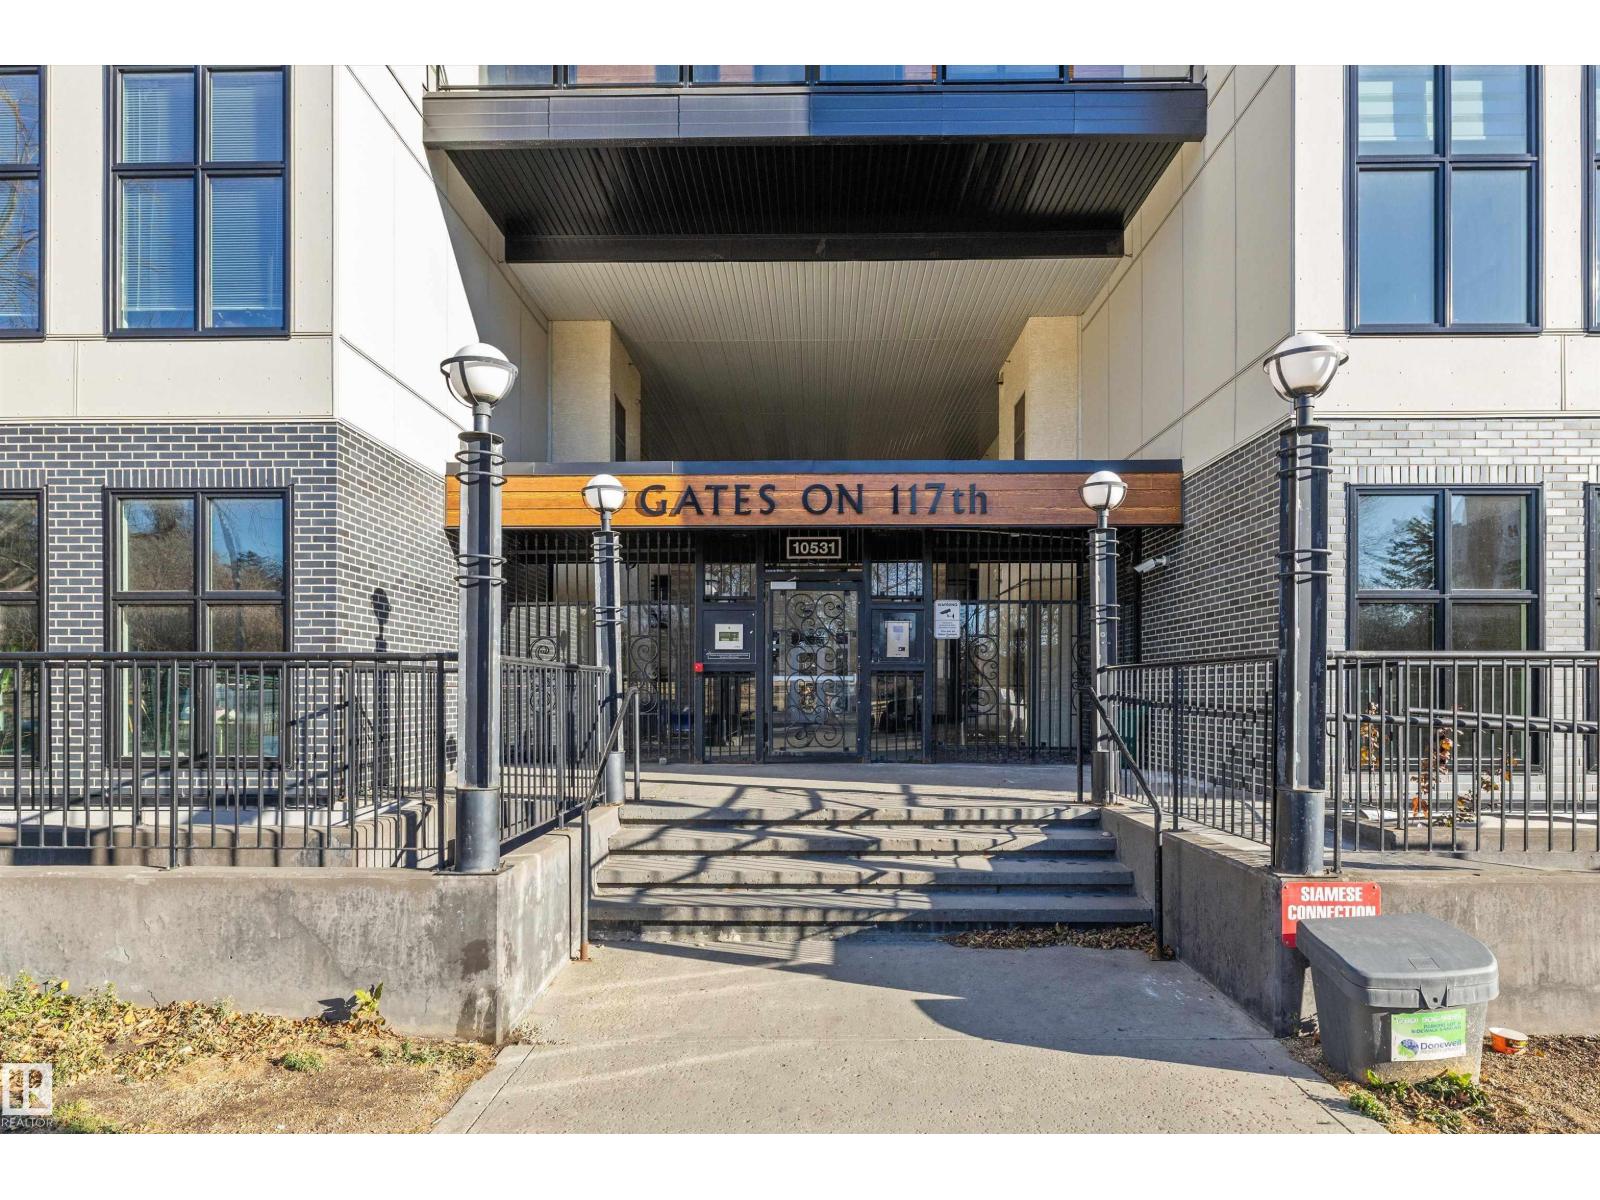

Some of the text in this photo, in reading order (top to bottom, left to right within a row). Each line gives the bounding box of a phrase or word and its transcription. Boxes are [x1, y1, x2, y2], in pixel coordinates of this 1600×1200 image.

[640, 482, 988, 517] GATES ON 117th
[792, 541, 836, 555] 10531
[1300, 886, 1364, 902] SIAMESE
[1287, 904, 1376, 920] CONNECTION
